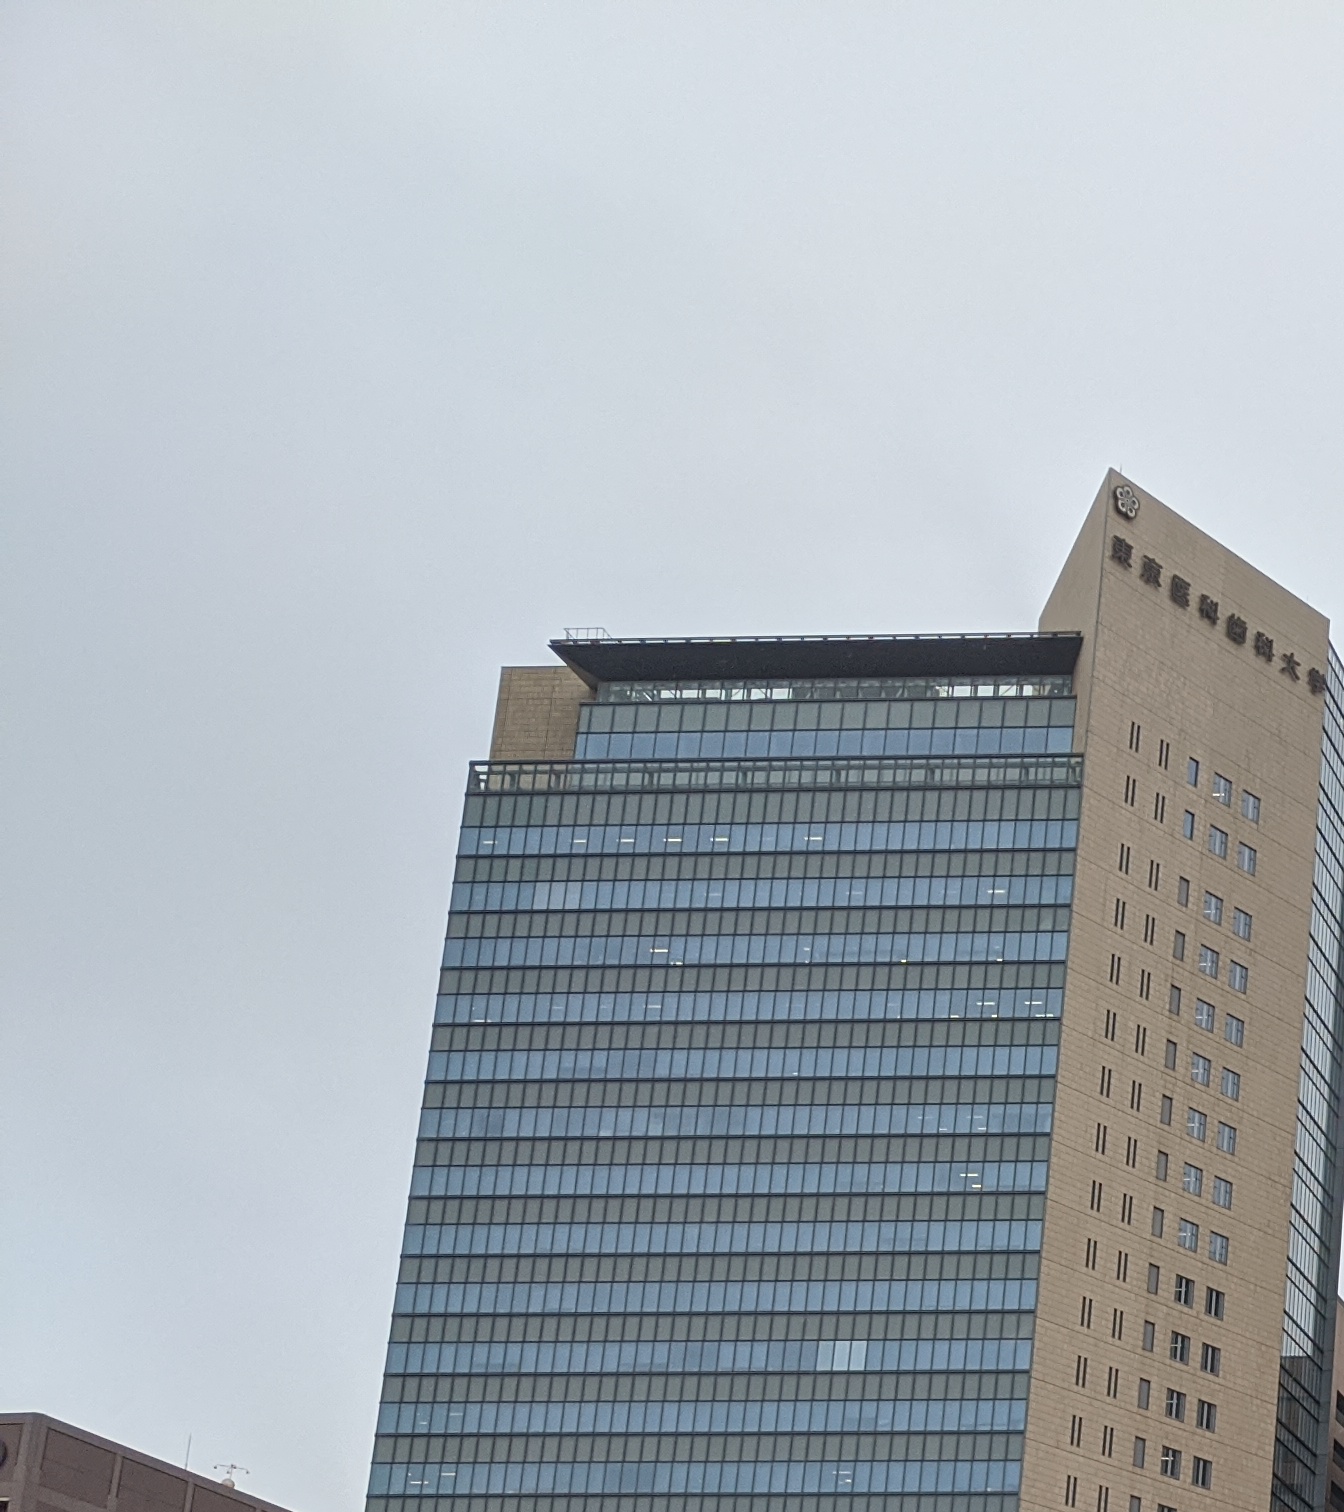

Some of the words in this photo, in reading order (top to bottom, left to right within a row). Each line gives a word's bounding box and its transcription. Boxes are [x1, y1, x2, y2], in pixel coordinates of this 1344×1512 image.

[1111, 534, 1326, 695] 東京医科歯科大学
